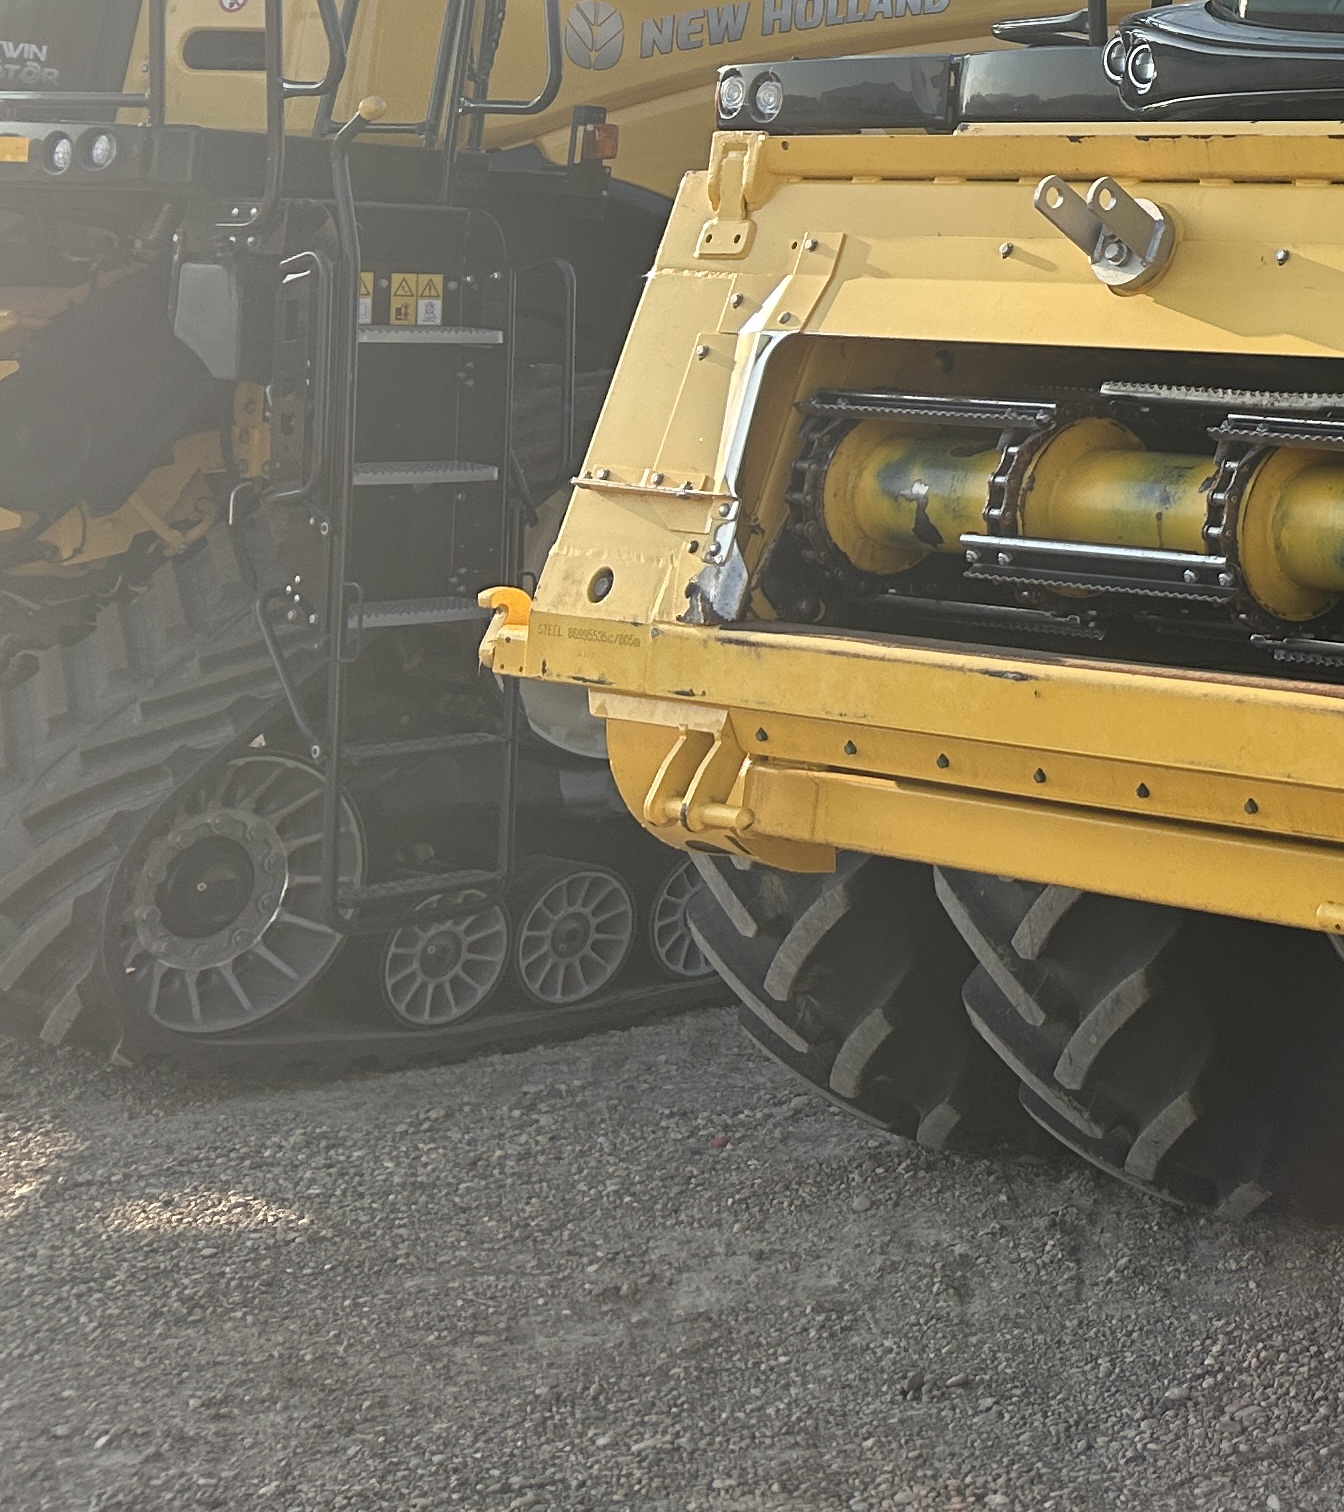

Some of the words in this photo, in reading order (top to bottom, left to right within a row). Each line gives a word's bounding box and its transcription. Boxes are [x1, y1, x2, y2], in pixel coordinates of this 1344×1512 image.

[640, 2, 750, 59] NEW
[0, 40, 48, 62] WIN
[0, 60, 59, 86] TOR
[537, 623, 564, 638] STEEL
